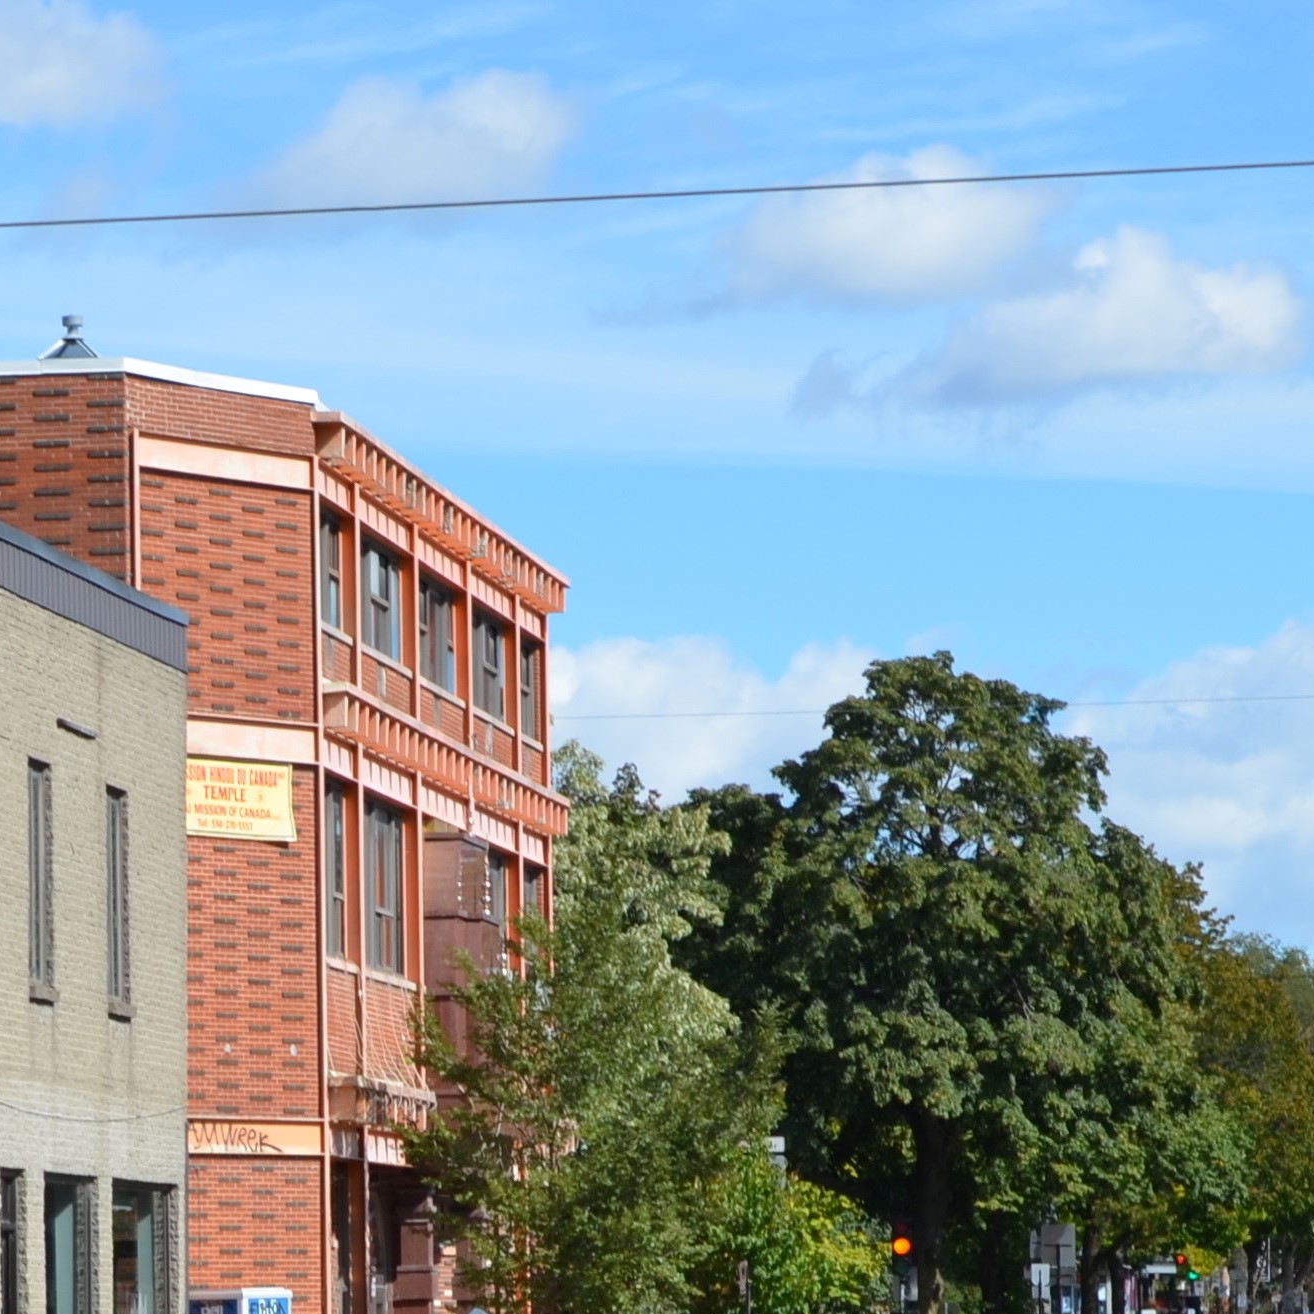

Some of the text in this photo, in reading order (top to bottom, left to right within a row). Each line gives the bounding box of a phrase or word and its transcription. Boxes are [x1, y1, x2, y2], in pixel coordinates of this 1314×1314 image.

[250, 769, 277, 787] CANADA
[203, 785, 246, 803] TEMPLE
[194, 804, 226, 816] MISSION
[229, 806, 237, 816] OF
[239, 807, 271, 819] CANADA
